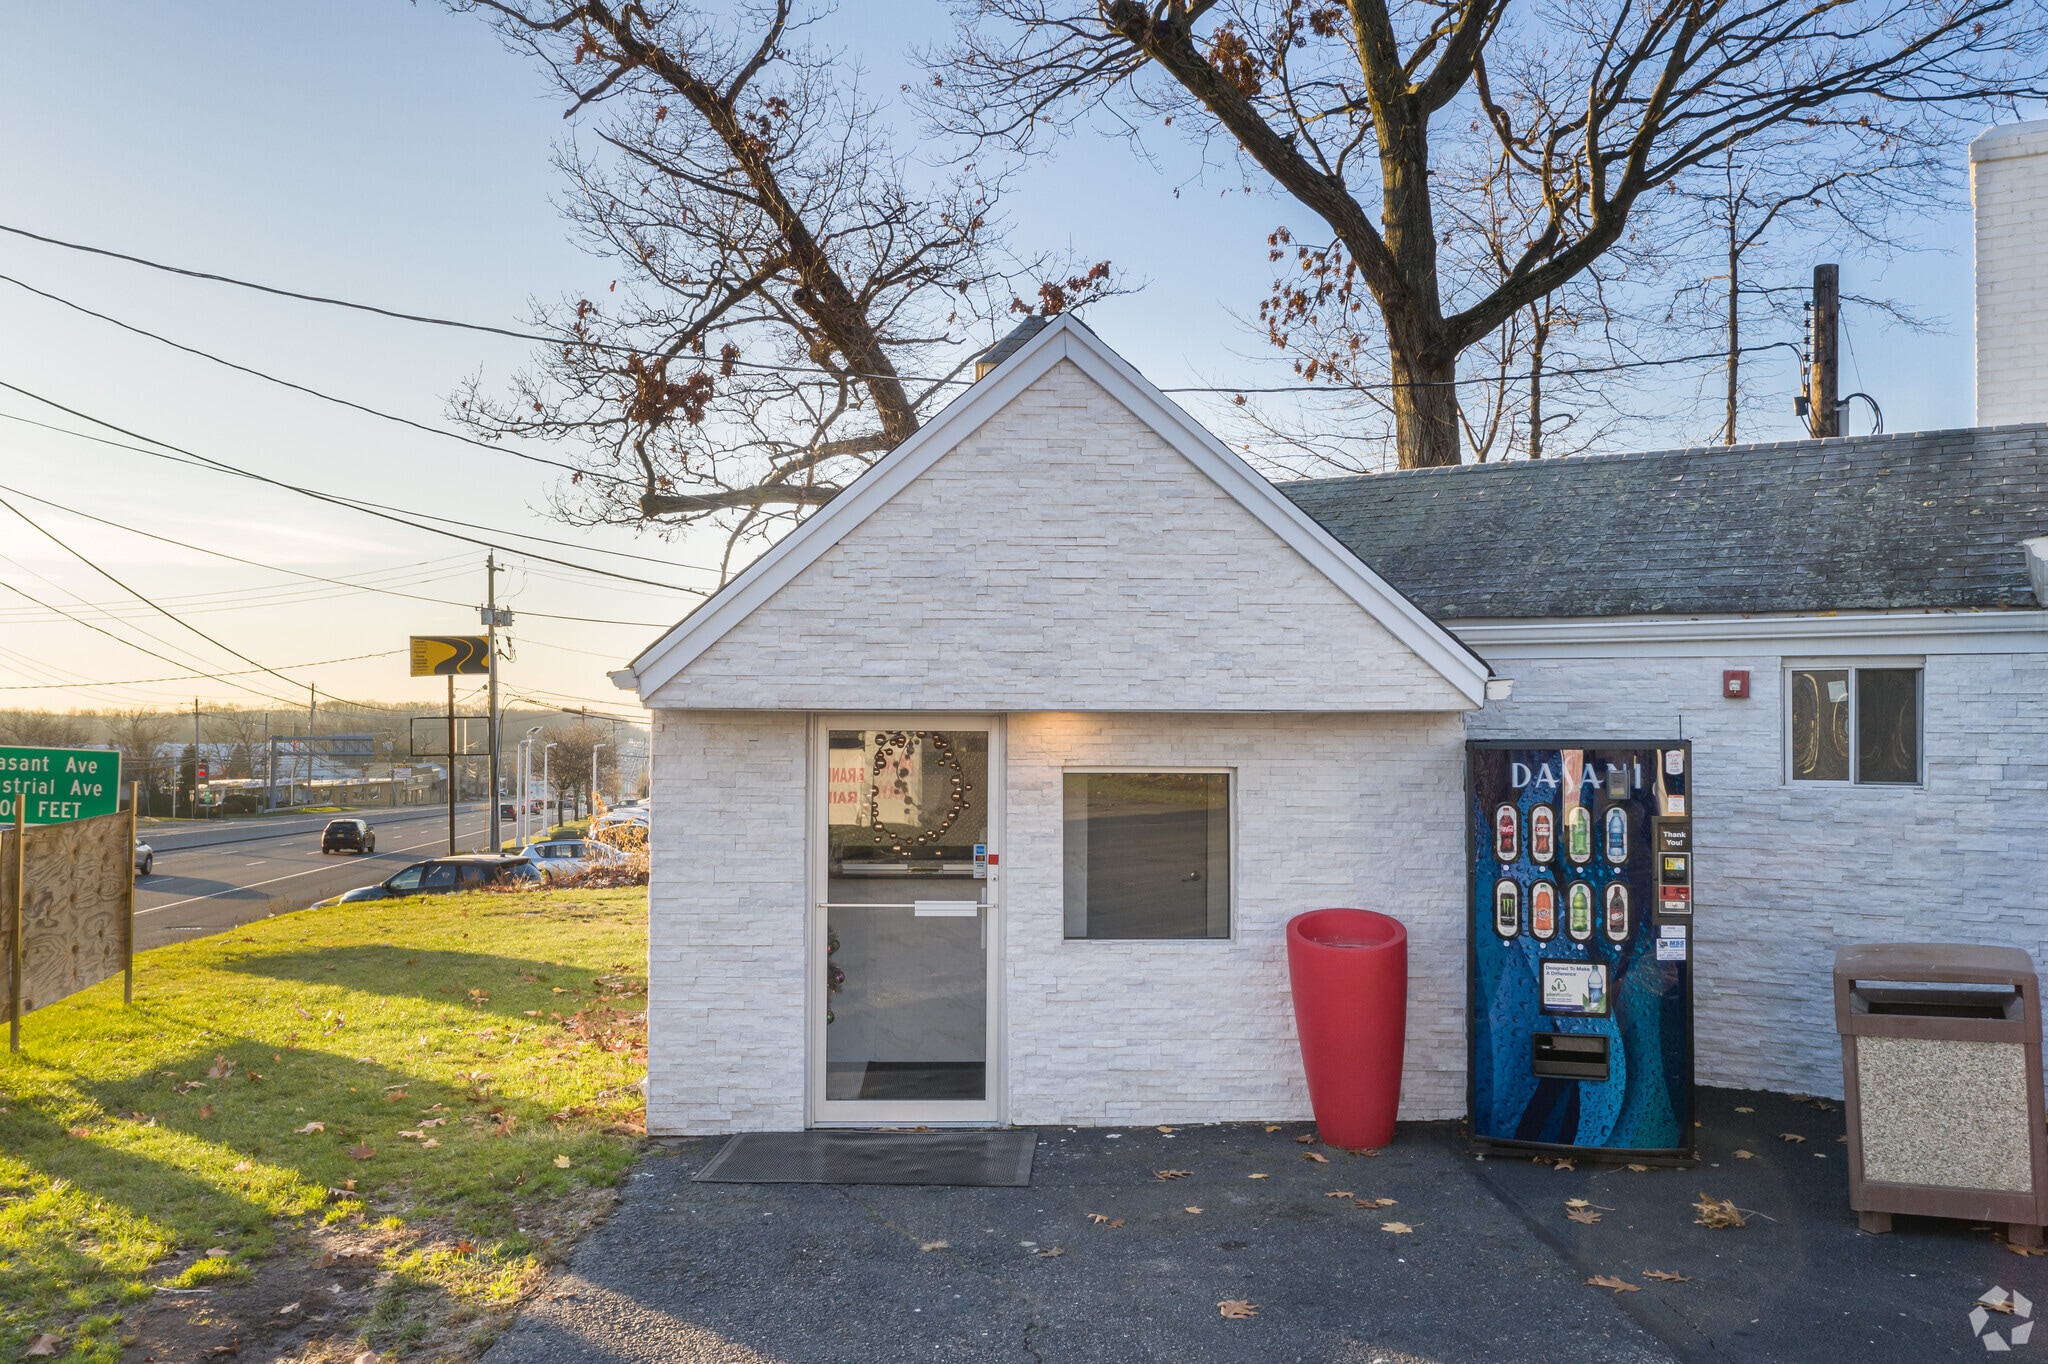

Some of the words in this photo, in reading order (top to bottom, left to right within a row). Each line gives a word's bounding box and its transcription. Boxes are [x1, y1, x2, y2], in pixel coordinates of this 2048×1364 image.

[65, 756, 98, 774] Ave
[1511, 762, 1641, 793] DASAI
[2, 778, 54, 795] strial
[70, 779, 103, 797] Ave
[38, 801, 82, 818] FEET
